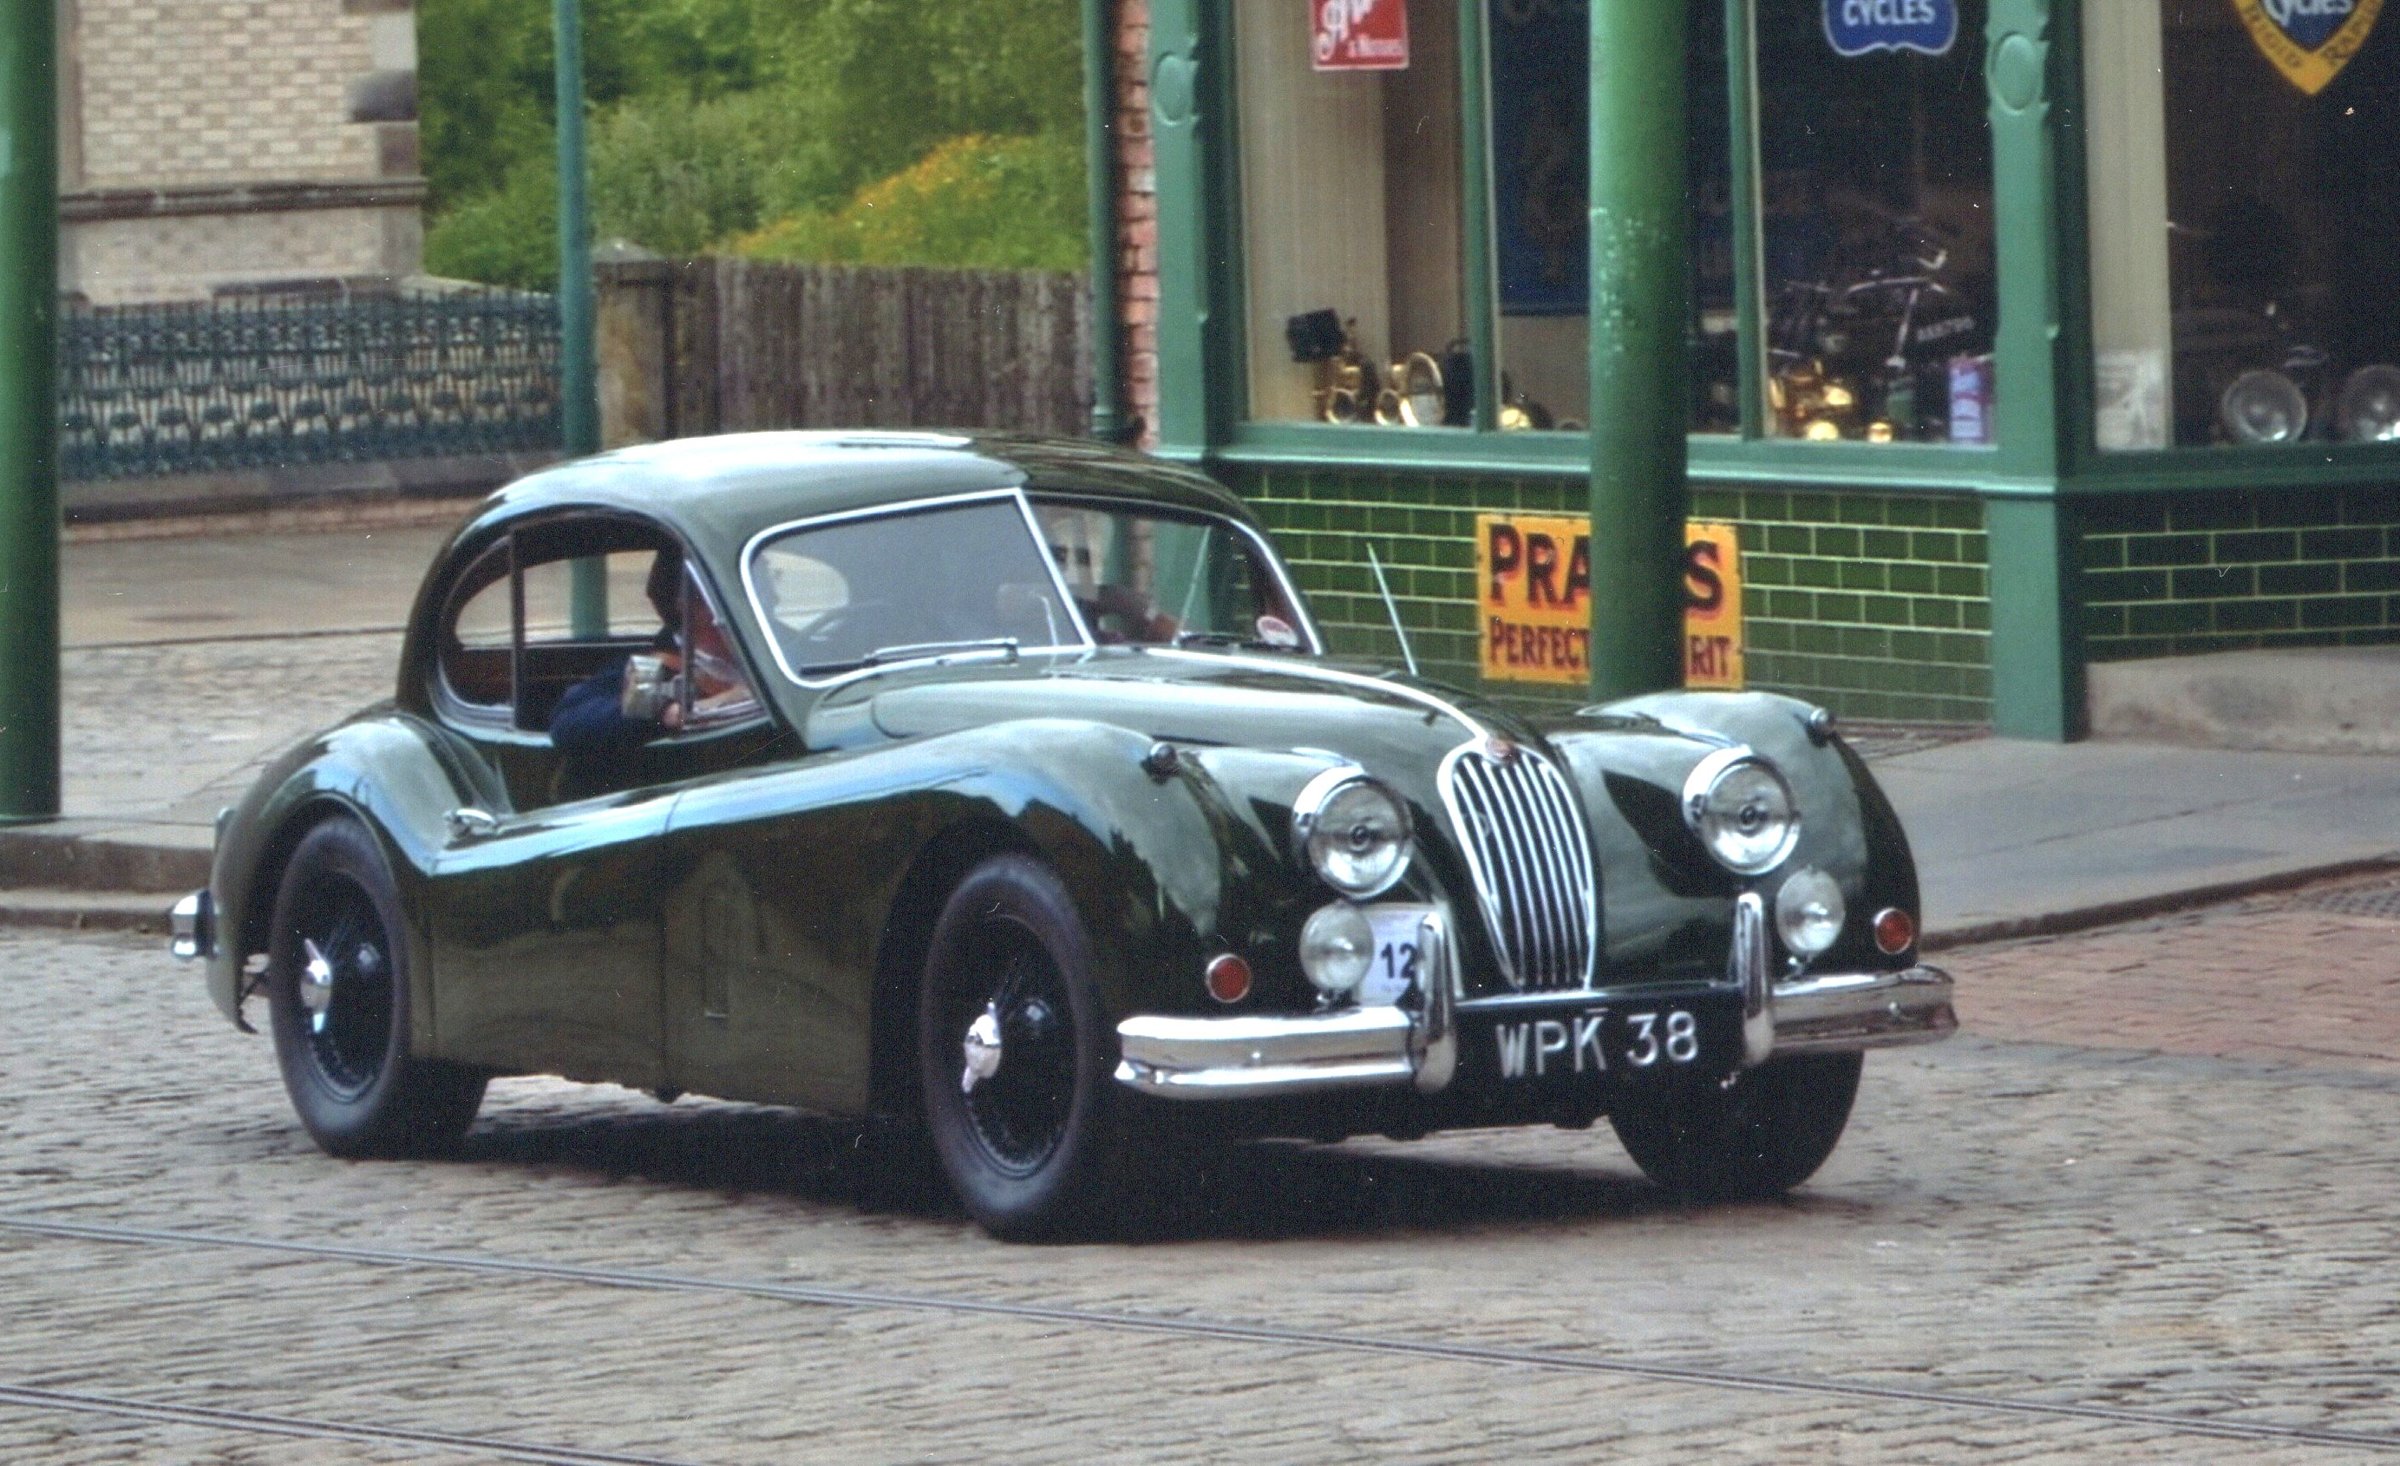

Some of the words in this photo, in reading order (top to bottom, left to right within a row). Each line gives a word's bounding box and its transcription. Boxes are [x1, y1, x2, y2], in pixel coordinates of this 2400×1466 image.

[1843, 0, 1936, 25] CYCLES
[1489, 524, 1723, 620] PRAS
[1496, 1016, 1607, 1079] WPK
[1626, 1010, 1699, 1067] 38
